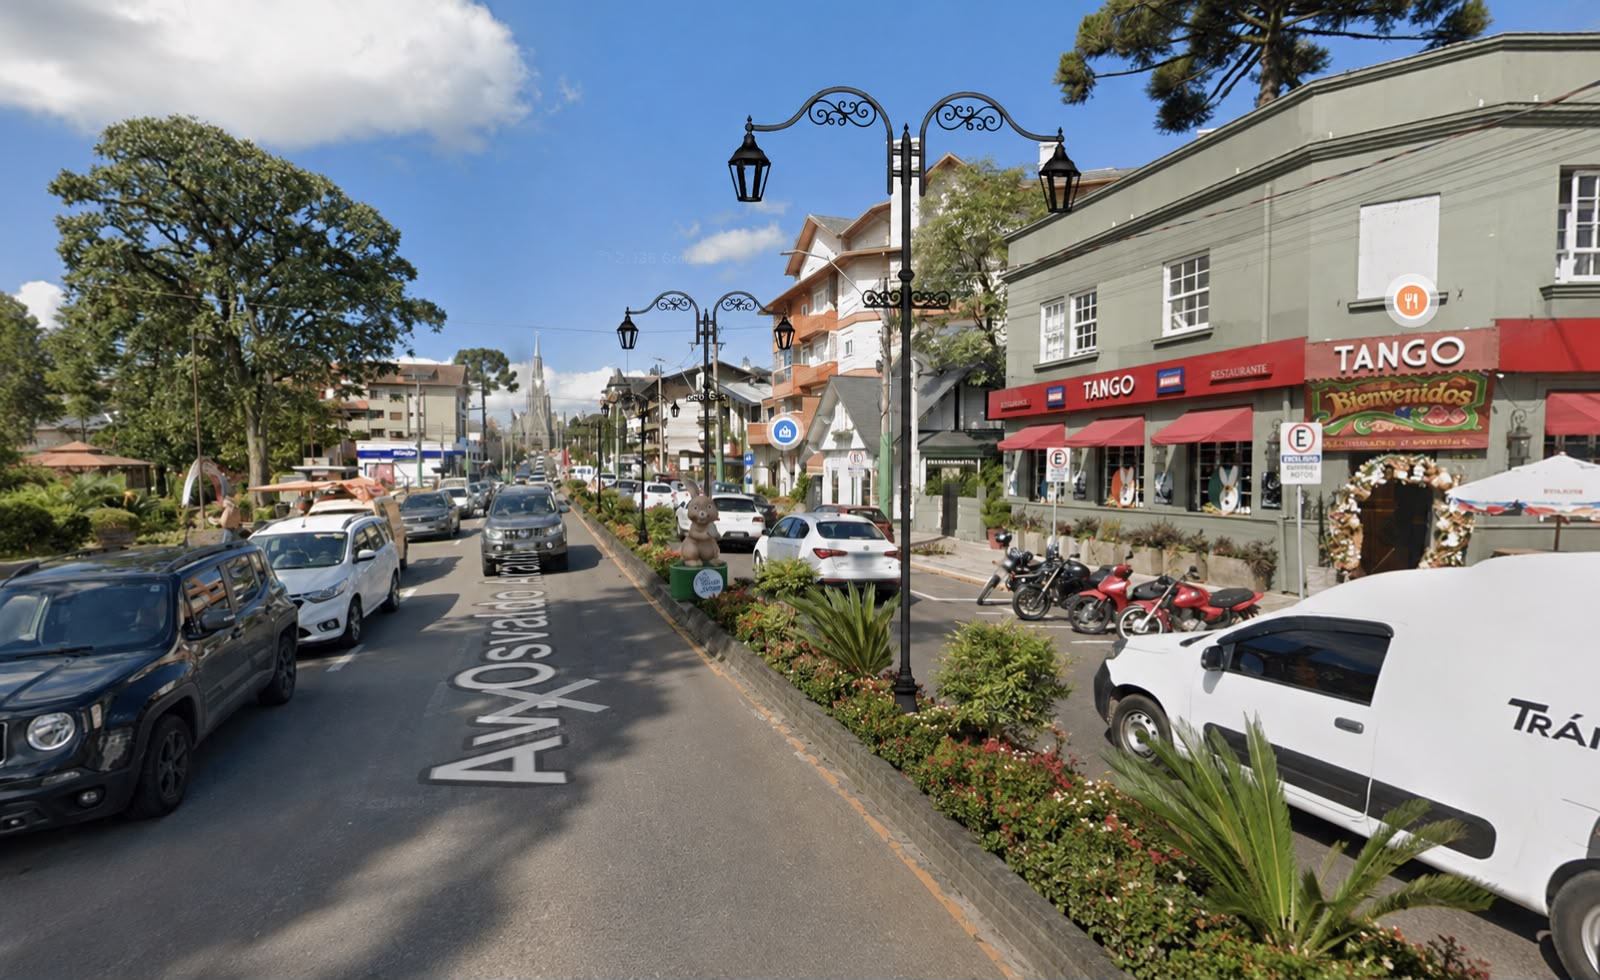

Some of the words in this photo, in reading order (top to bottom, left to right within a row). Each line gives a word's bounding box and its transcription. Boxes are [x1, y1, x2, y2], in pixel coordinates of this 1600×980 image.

[1334, 336, 1466, 372] TANGO
[1210, 363, 1268, 379] RESTAURANTE
[1083, 375, 1135, 400] TANGO
[1326, 382, 1473, 420] Bienvenidos
[1296, 429, 1307, 447] E
[1055, 452, 1063, 465] E
